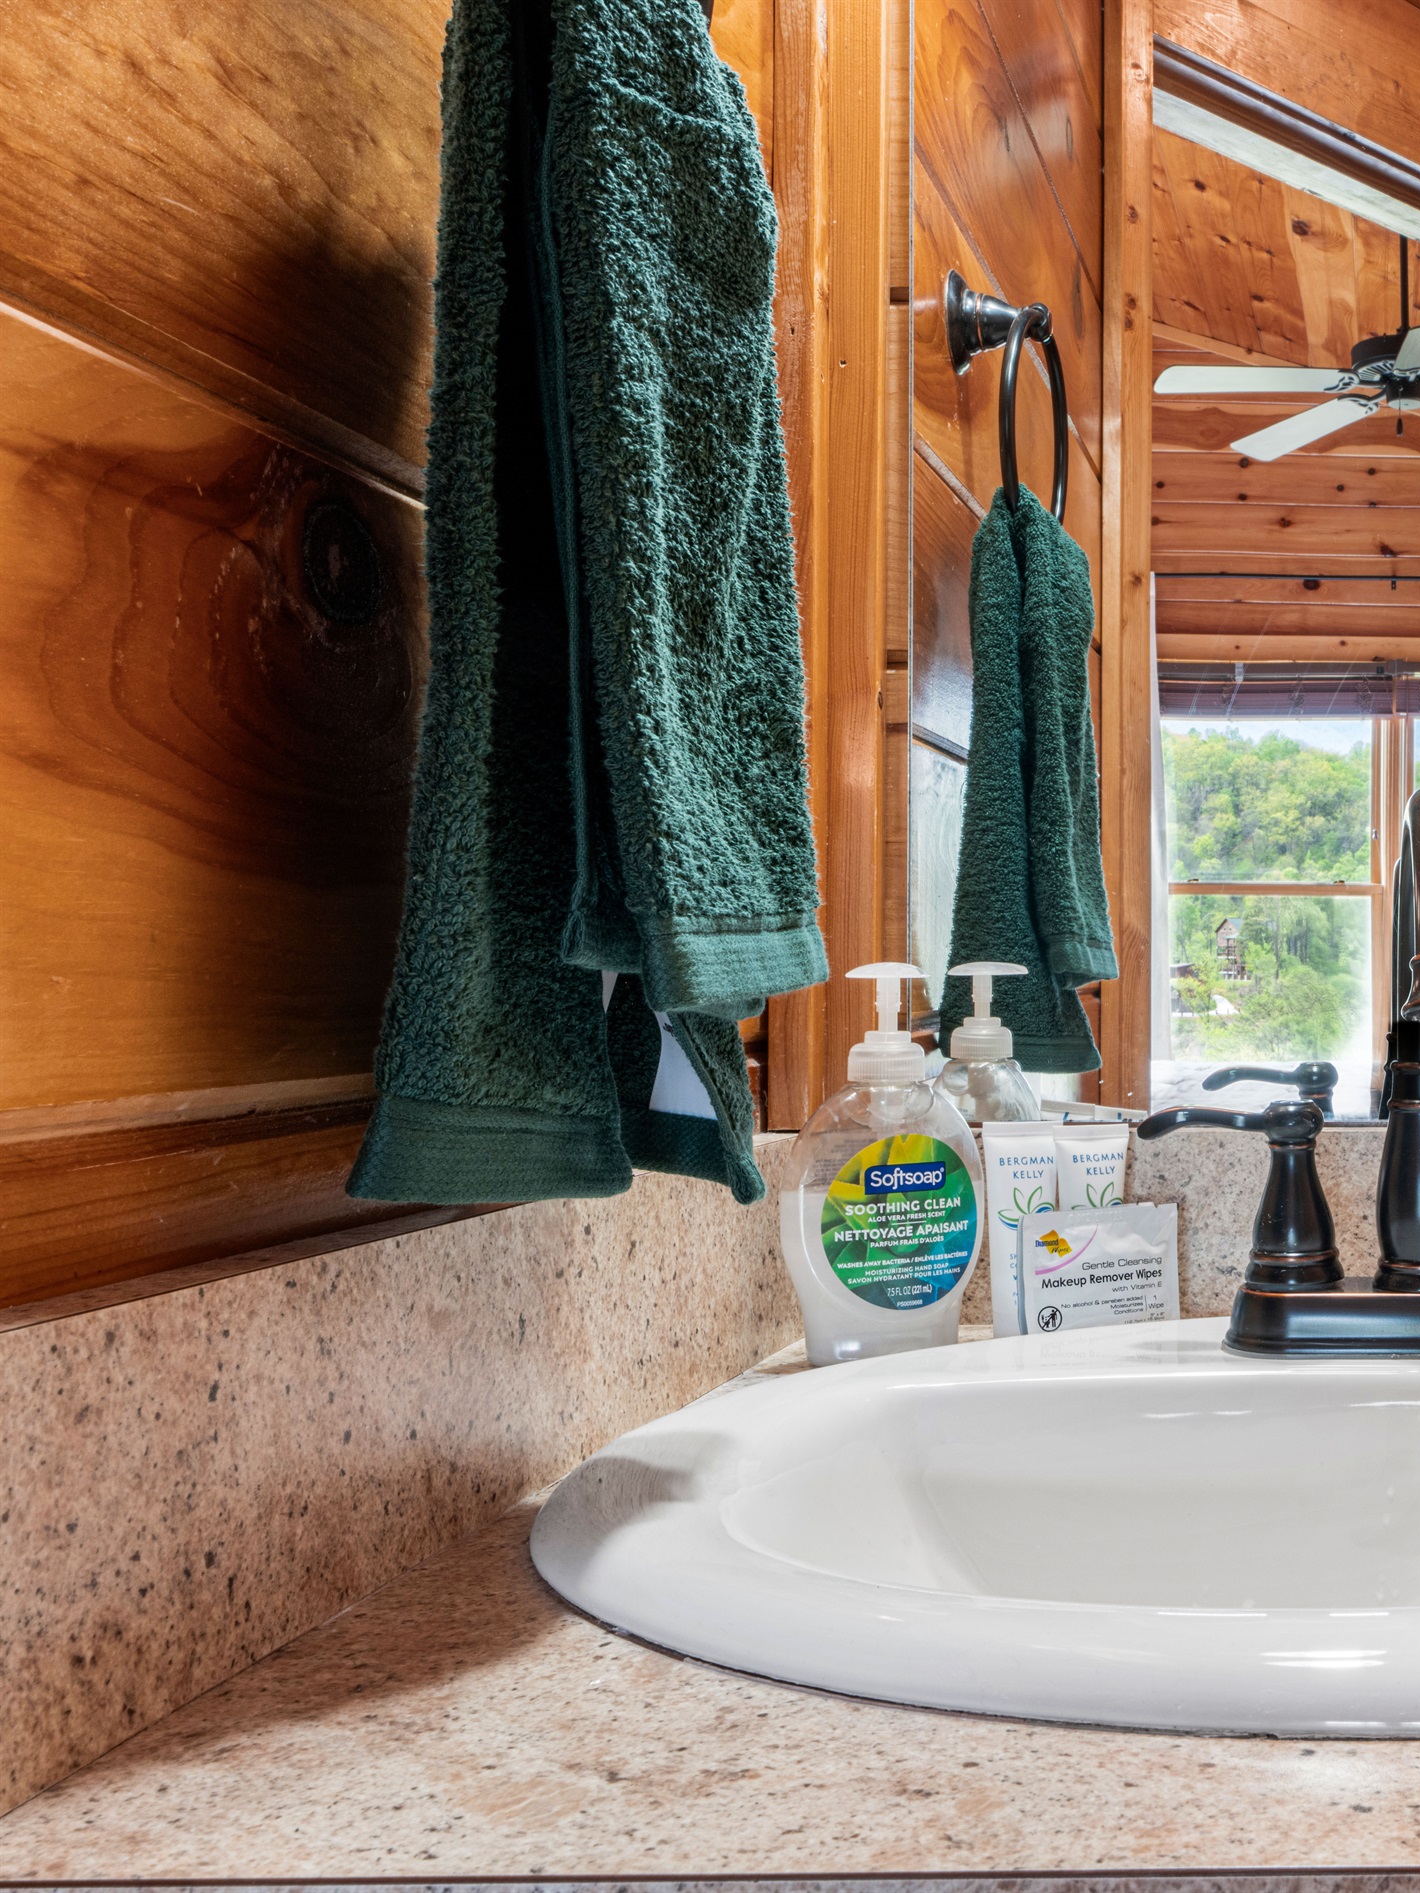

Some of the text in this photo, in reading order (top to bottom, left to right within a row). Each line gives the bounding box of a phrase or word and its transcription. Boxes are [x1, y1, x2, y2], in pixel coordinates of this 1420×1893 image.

[999, 1156, 1054, 1167] BERGMAN
[1072, 1152, 1124, 1163] BERGMAN
[1013, 1170, 1044, 1179] KELLY
[1086, 1166, 1116, 1176] KELLY
[845, 1197, 961, 1216] SOOTHING CLEAN
[868, 1215, 886, 1223] ALOE
[907, 1212, 927, 1220] FRESH
[927, 1210, 946, 1218] SCENT
[834, 1220, 969, 1242] NETTOYAGE APAISANT
[870, 1234, 944, 1248] PARFUM FRAIS D'ALOÈS
[1035, 1239, 1059, 1247] Diamond
[837, 1261, 863, 1269] WASHES
[882, 1258, 911, 1266] BACTERIA
[914, 1254, 934, 1262] ENLÈVE
[1082, 1256, 1162, 1271] Gentle Cleansing
[865, 1267, 913, 1276] MOISTURIZING
[914, 1264, 933, 1272] HAND
[847, 1277, 872, 1285] SAVON
[873, 1274, 913, 1282] HYDRATANT
[1041, 1268, 1162, 1289] Makeup Remover Wipes
[887, 1288, 895, 1297] 7.5
[895, 1287, 903, 1296] FL
[903, 1286, 911, 1295] OZ
[1112, 1285, 1129, 1293] with
[1130, 1282, 1156, 1291] Vitamin
[1101, 1297, 1126, 1305] paraben
